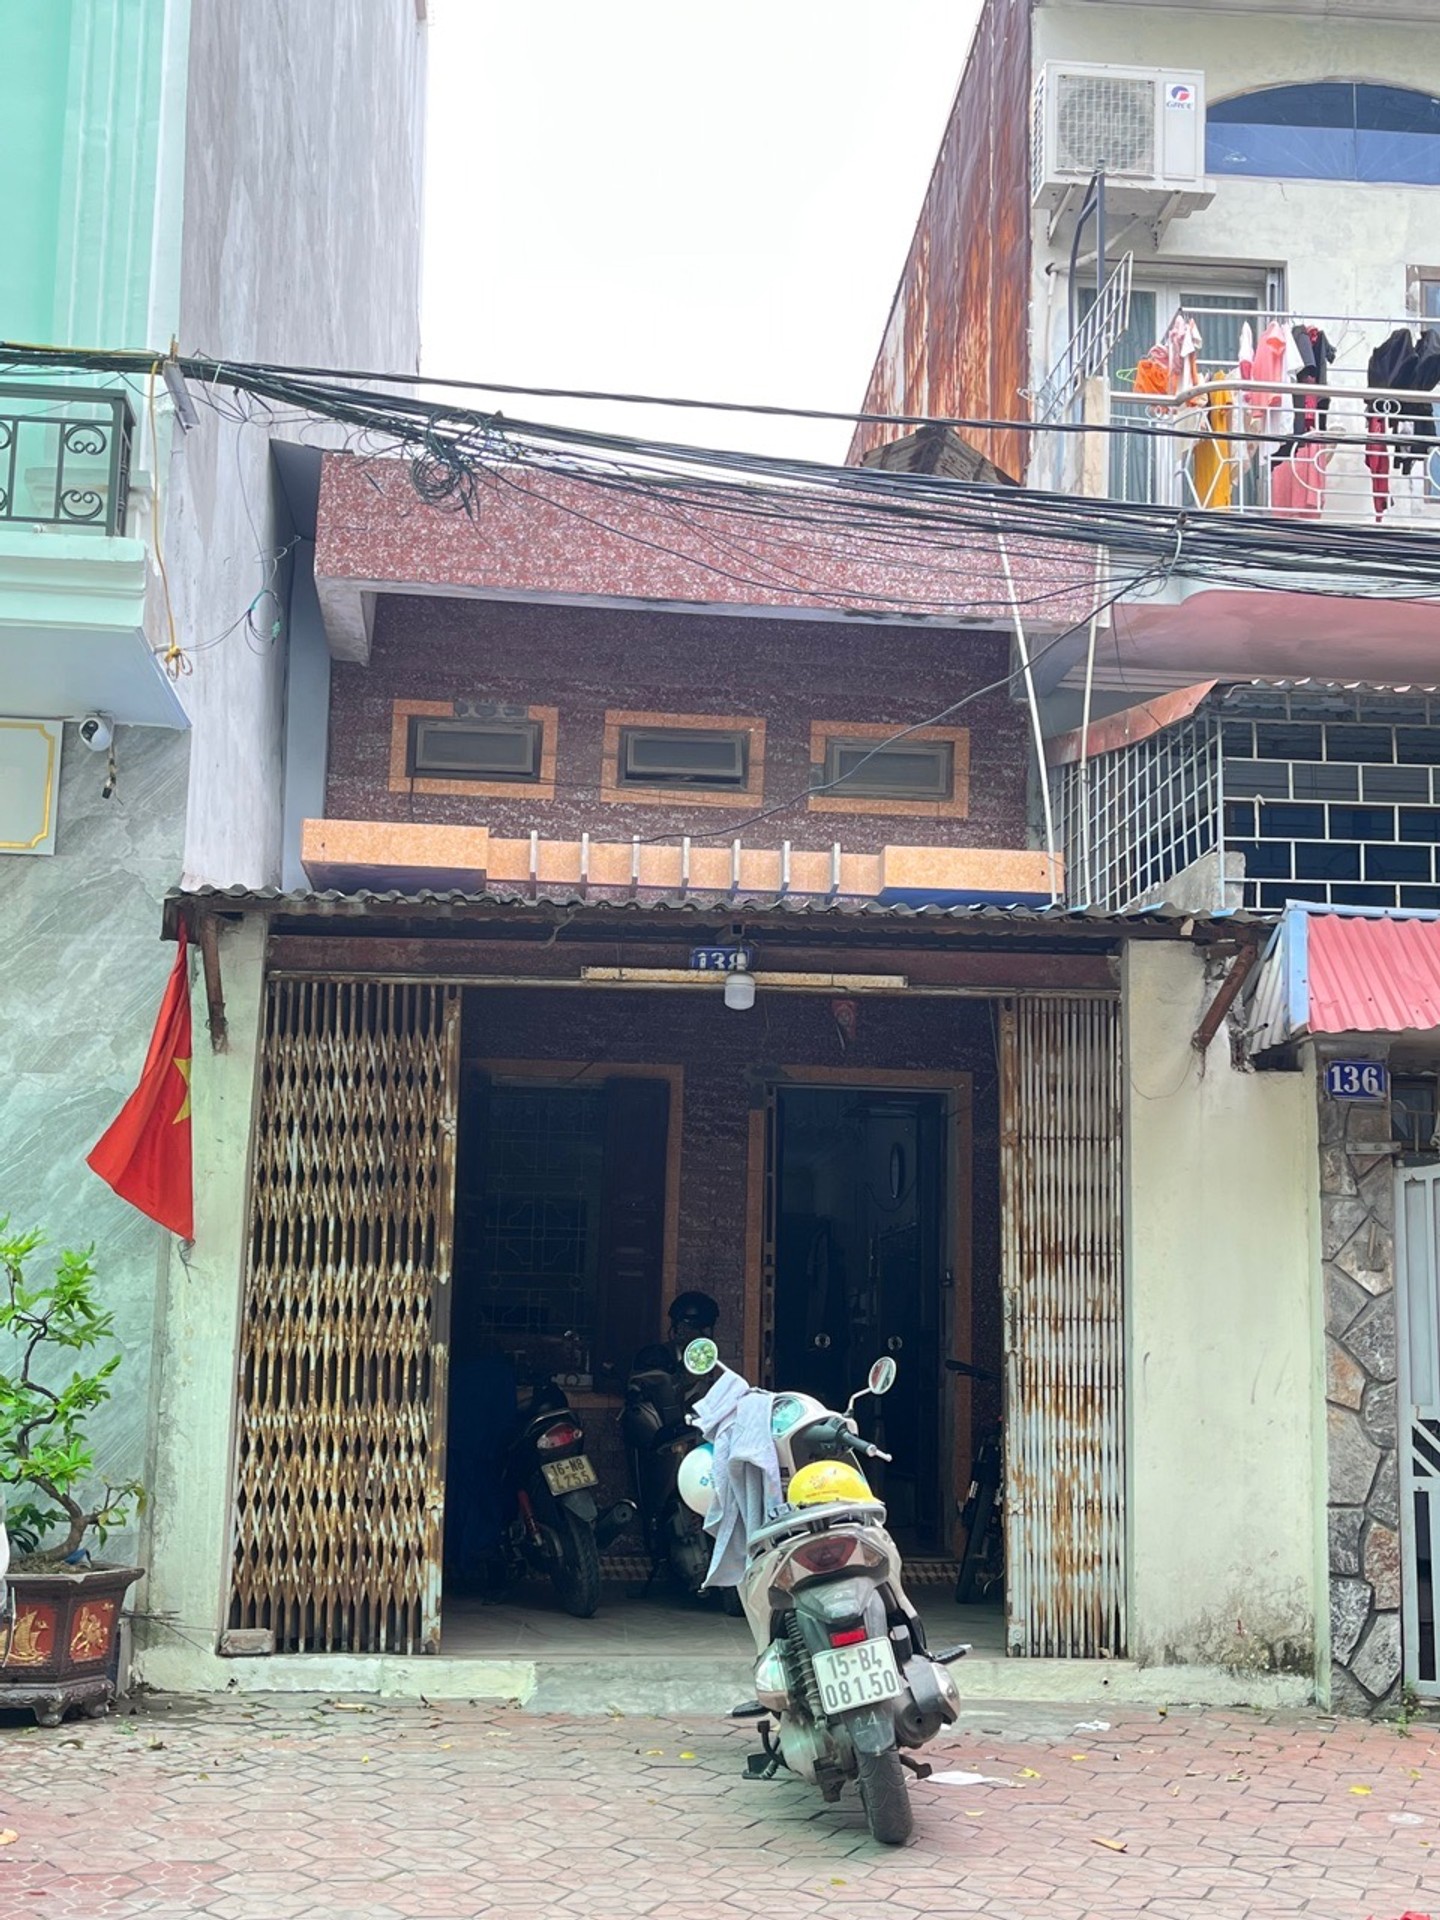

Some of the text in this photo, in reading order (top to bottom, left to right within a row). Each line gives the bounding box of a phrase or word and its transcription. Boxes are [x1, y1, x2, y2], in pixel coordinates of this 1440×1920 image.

[1331, 1065, 1379, 1095] 136
[826, 1645, 883, 1679] 15-B4
[825, 1670, 897, 1708] 081.50
